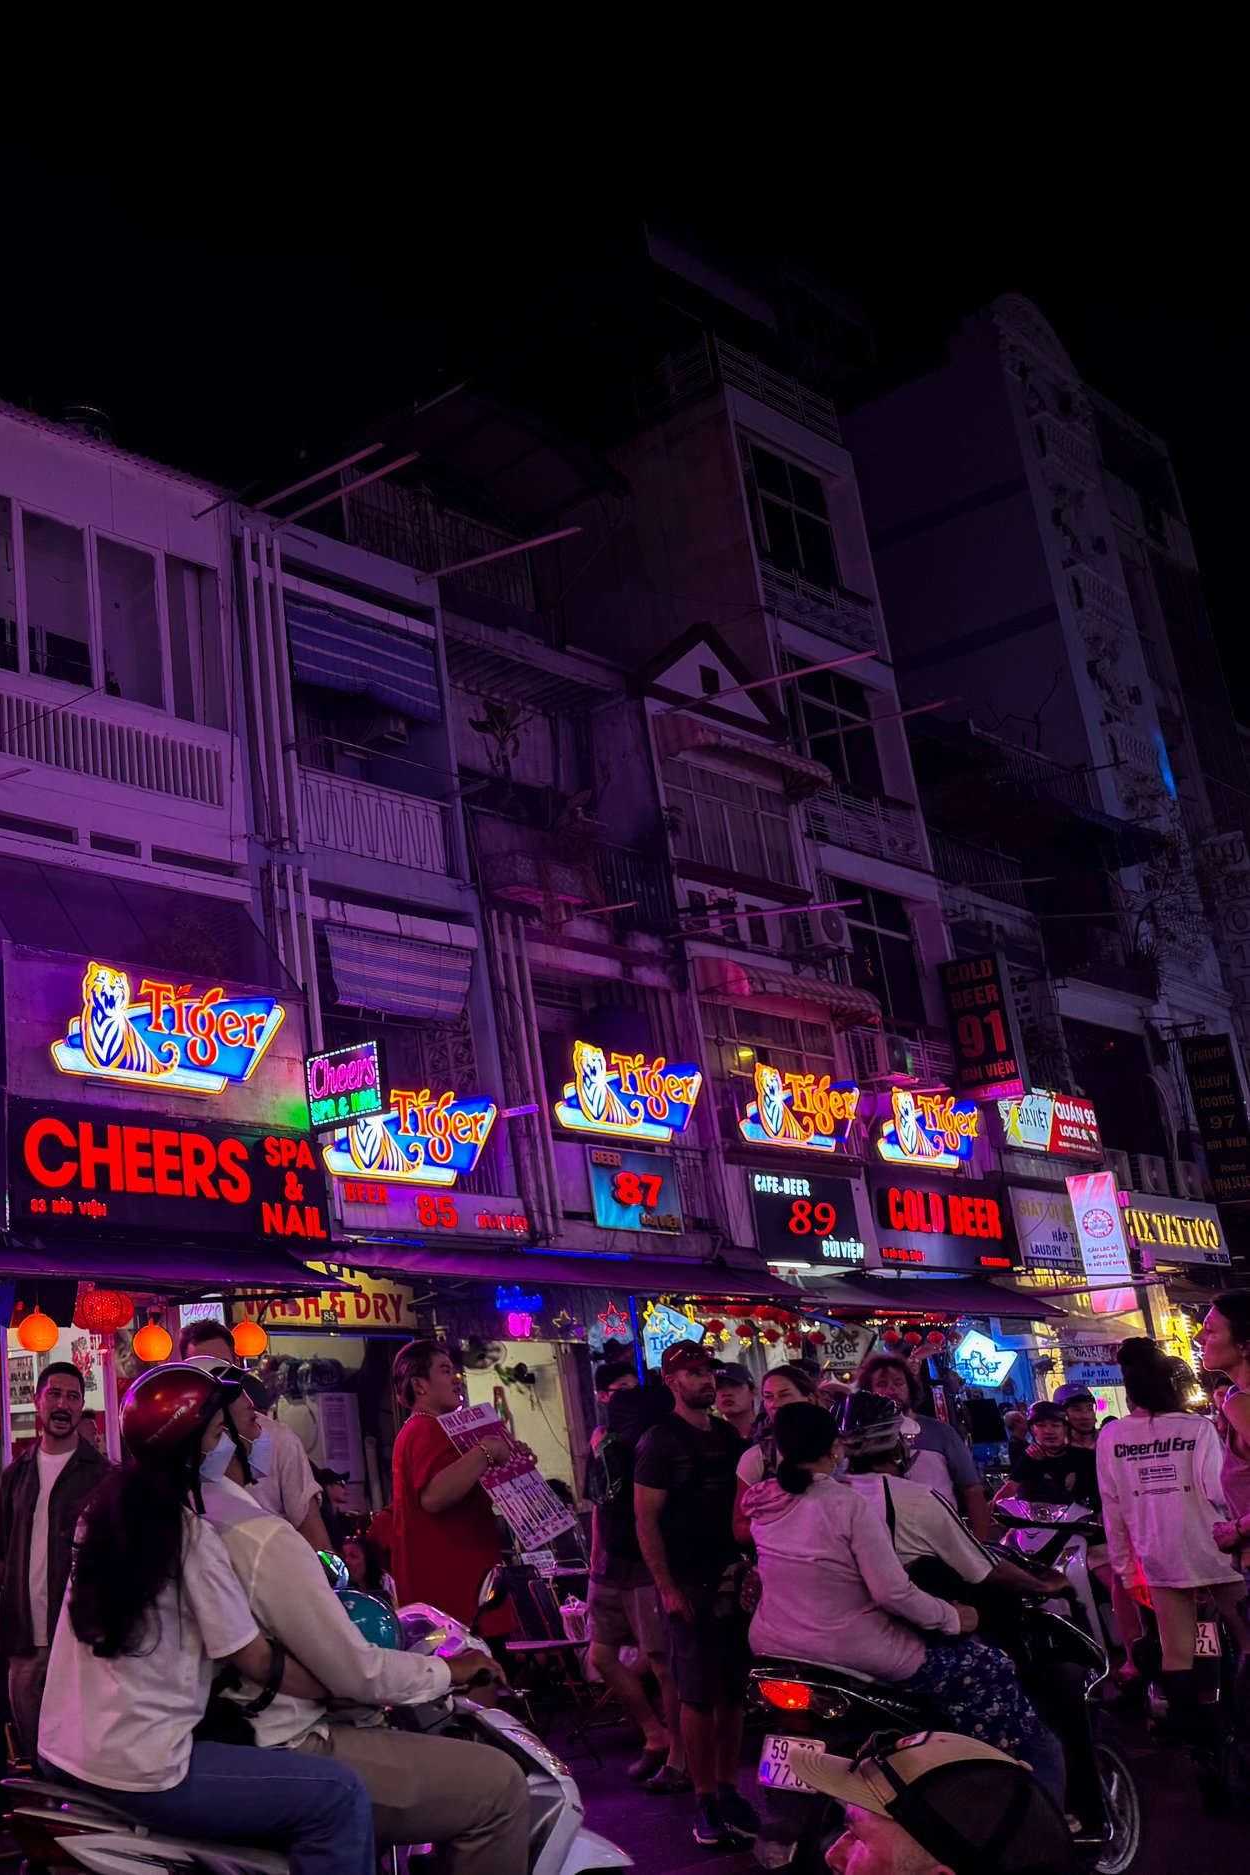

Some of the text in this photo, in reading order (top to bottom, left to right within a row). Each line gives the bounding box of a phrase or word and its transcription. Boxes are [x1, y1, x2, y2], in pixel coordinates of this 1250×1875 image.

[945, 958, 994, 985] COLD
[950, 983, 1000, 1011] BEER
[140, 979, 266, 1067] Tiger
[956, 1009, 1008, 1059] 91
[310, 1055, 376, 1099] Cheers
[611, 1053, 698, 1120] Tiger
[985, 1059, 1016, 1079] VIỆN
[784, 1072, 858, 1136] Tiger
[1054, 1101, 1097, 1127] QUÁN 93
[390, 1088, 486, 1163] Tiger
[917, 1094, 979, 1151] Tiger
[1209, 1114, 1237, 1130] 97
[23, 1117, 252, 1204] CHEERS
[263, 1135, 316, 1170] SPA
[591, 1150, 622, 1168] BEER
[283, 1172, 304, 1201] &
[343, 1181, 390, 1205] BEER
[614, 1171, 664, 1208] 87
[262, 1202, 327, 1239] NAIL
[416, 1194, 459, 1229] 85
[789, 1200, 836, 1236] 89
[888, 1187, 1003, 1240] COLD BEER
[1152, 1212, 1220, 1250] TATTOO
[323, 1311, 336, 1321] 85
[350, 1293, 403, 1323] DRY
[823, 1339, 859, 1360] Tiger
[1114, 1437, 1171, 1458] Cheerful
[1172, 1437, 1196, 1451] Era
[771, 1739, 789, 1761] 59
